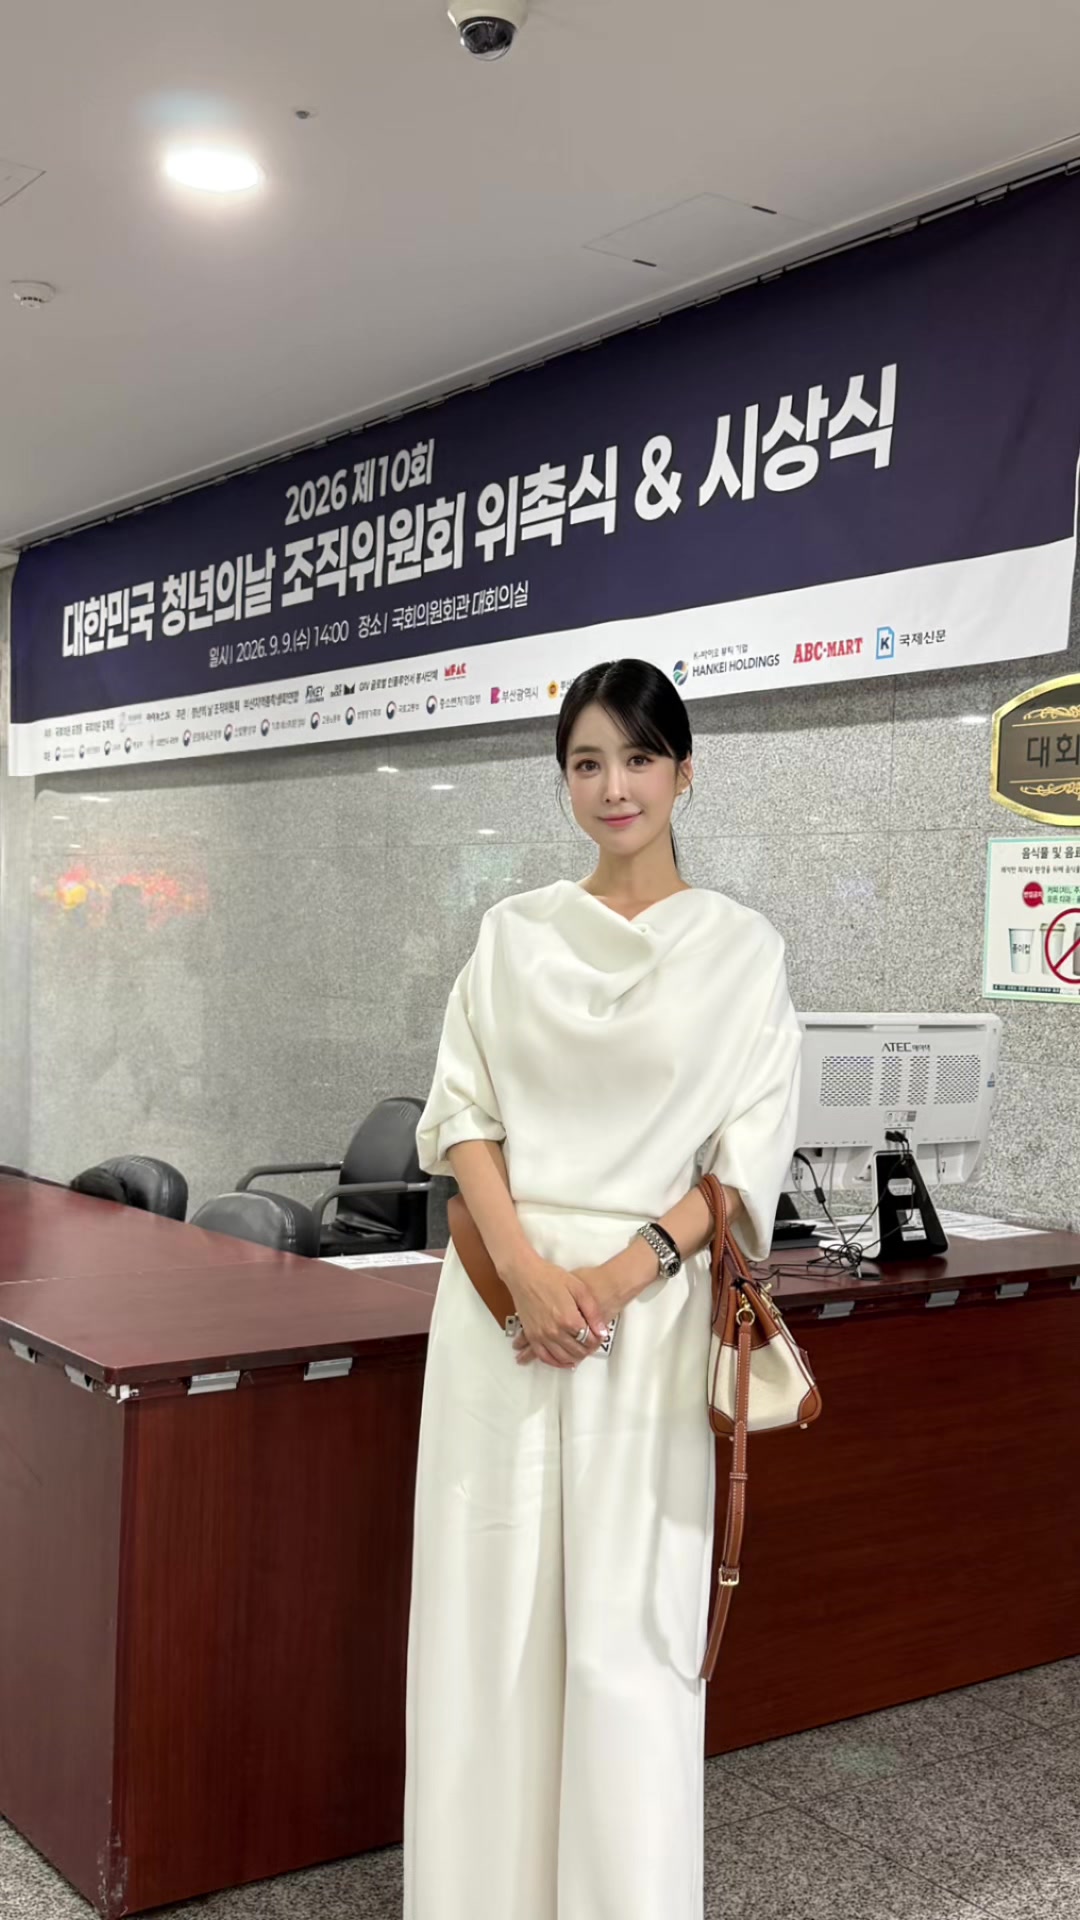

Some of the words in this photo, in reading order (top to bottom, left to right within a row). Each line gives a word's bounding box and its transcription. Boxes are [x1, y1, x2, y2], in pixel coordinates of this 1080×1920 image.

[285, 470, 347, 526] 2026
[352, 438, 435, 505] 제10회
[62, 581, 155, 657] 대한민국
[161, 547, 277, 637] 청년의날
[281, 492, 466, 608] 조직위원회
[474, 445, 618, 562] 위촉식
[634, 434, 683, 521] &
[698, 363, 897, 507] 시상식
[313, 620, 350, 647] 14:00
[391, 594, 470, 632] 국회의원회관
[472, 580, 529, 616] 대회의실
[899, 629, 947, 647] 국제신문
[692, 661, 728, 678] HANKEI
[728, 654, 780, 672] HOLDINGS
[502, 686, 539, 703] 부산광역시
[1026, 733, 1080, 768] 대회
[1022, 846, 1049, 860] 음식물
[1052, 846, 1062, 859] 및
[1012, 943, 1031, 955] 종이컵
[882, 1042, 912, 1052] ATEC
